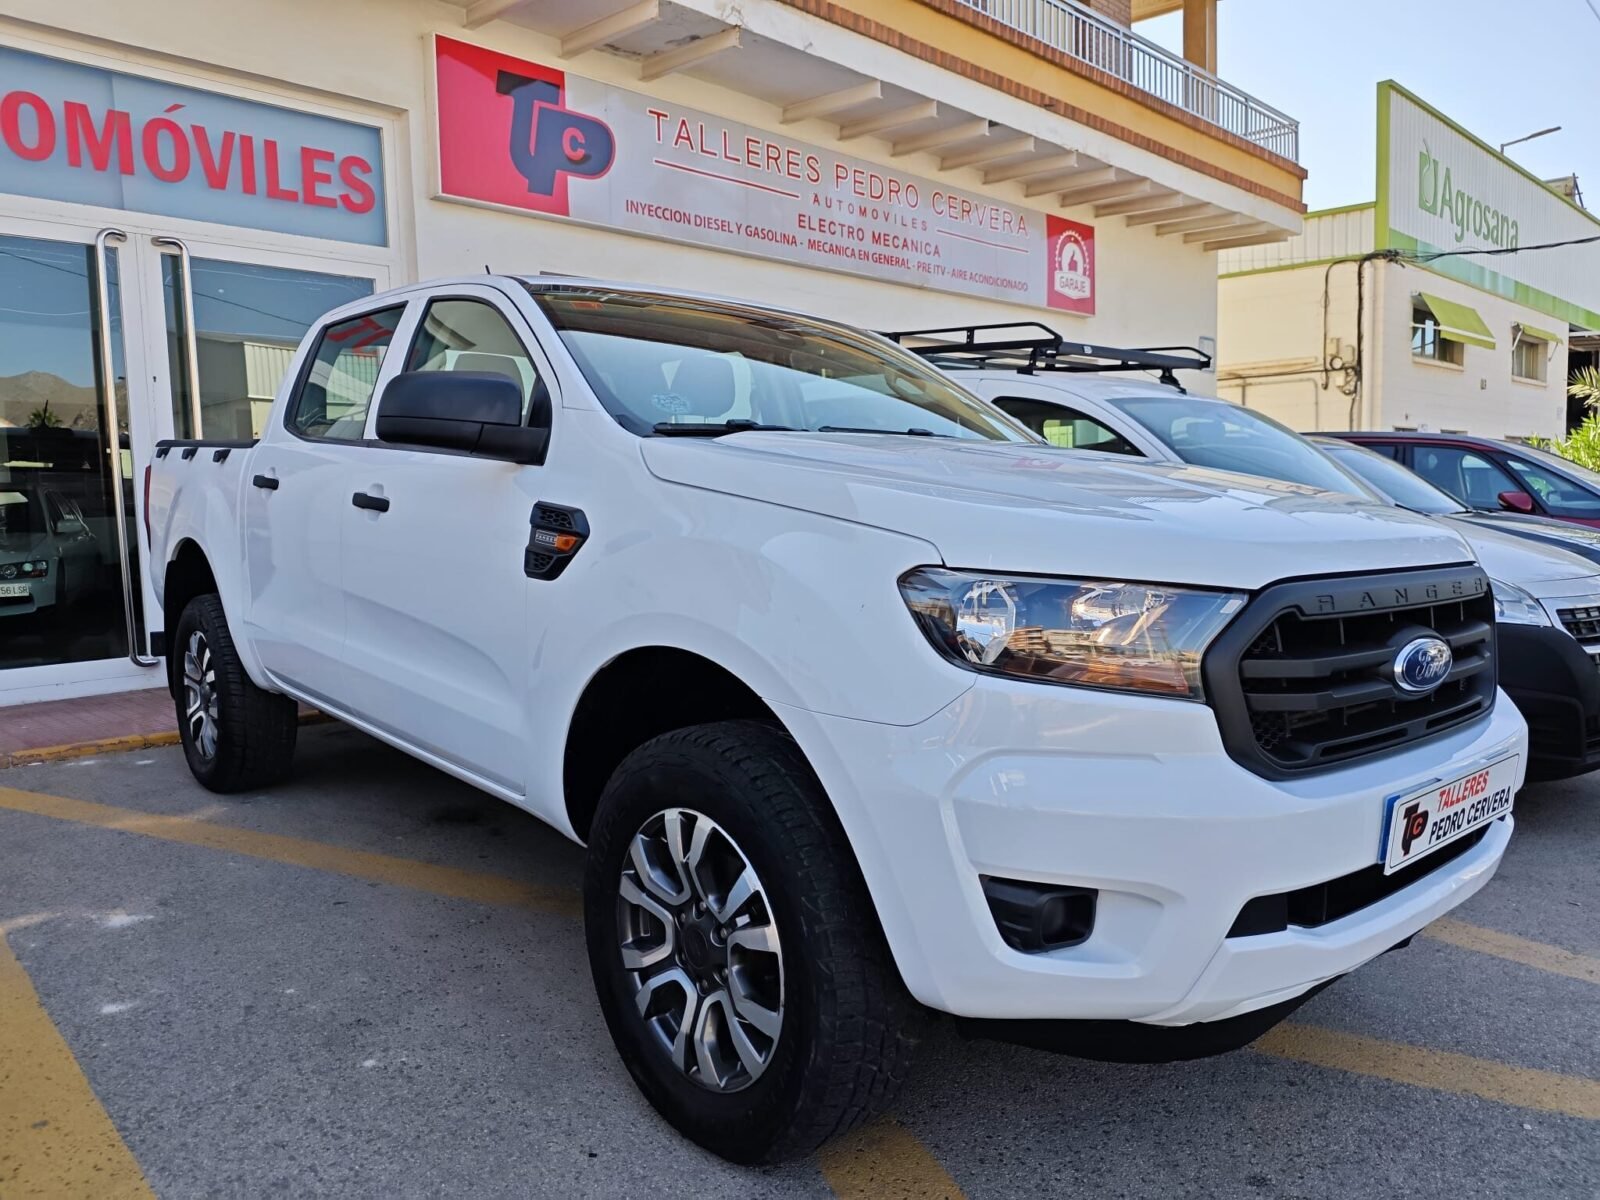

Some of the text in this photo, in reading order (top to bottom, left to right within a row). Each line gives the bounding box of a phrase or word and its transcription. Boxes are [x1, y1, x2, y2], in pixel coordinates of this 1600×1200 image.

[648, 109, 1029, 237] TALLERES PEDRO CERVERA
[798, 213, 942, 258] ELECTRO MECANICA
[813, 193, 928, 232] AUTOMOVILES
[1440, 167, 1519, 254] Agrosana
[625, 199, 1029, 292] INYECCION DIESEL Y GASOLINA MECANICA EN GENERAL PRE ITV AIRE ACONDICIONADO
[1059, 275, 1087, 294] GARAJE
[1428, 786, 1511, 845] PEDRO CERVERA
[1437, 770, 1489, 813] TALLERES
